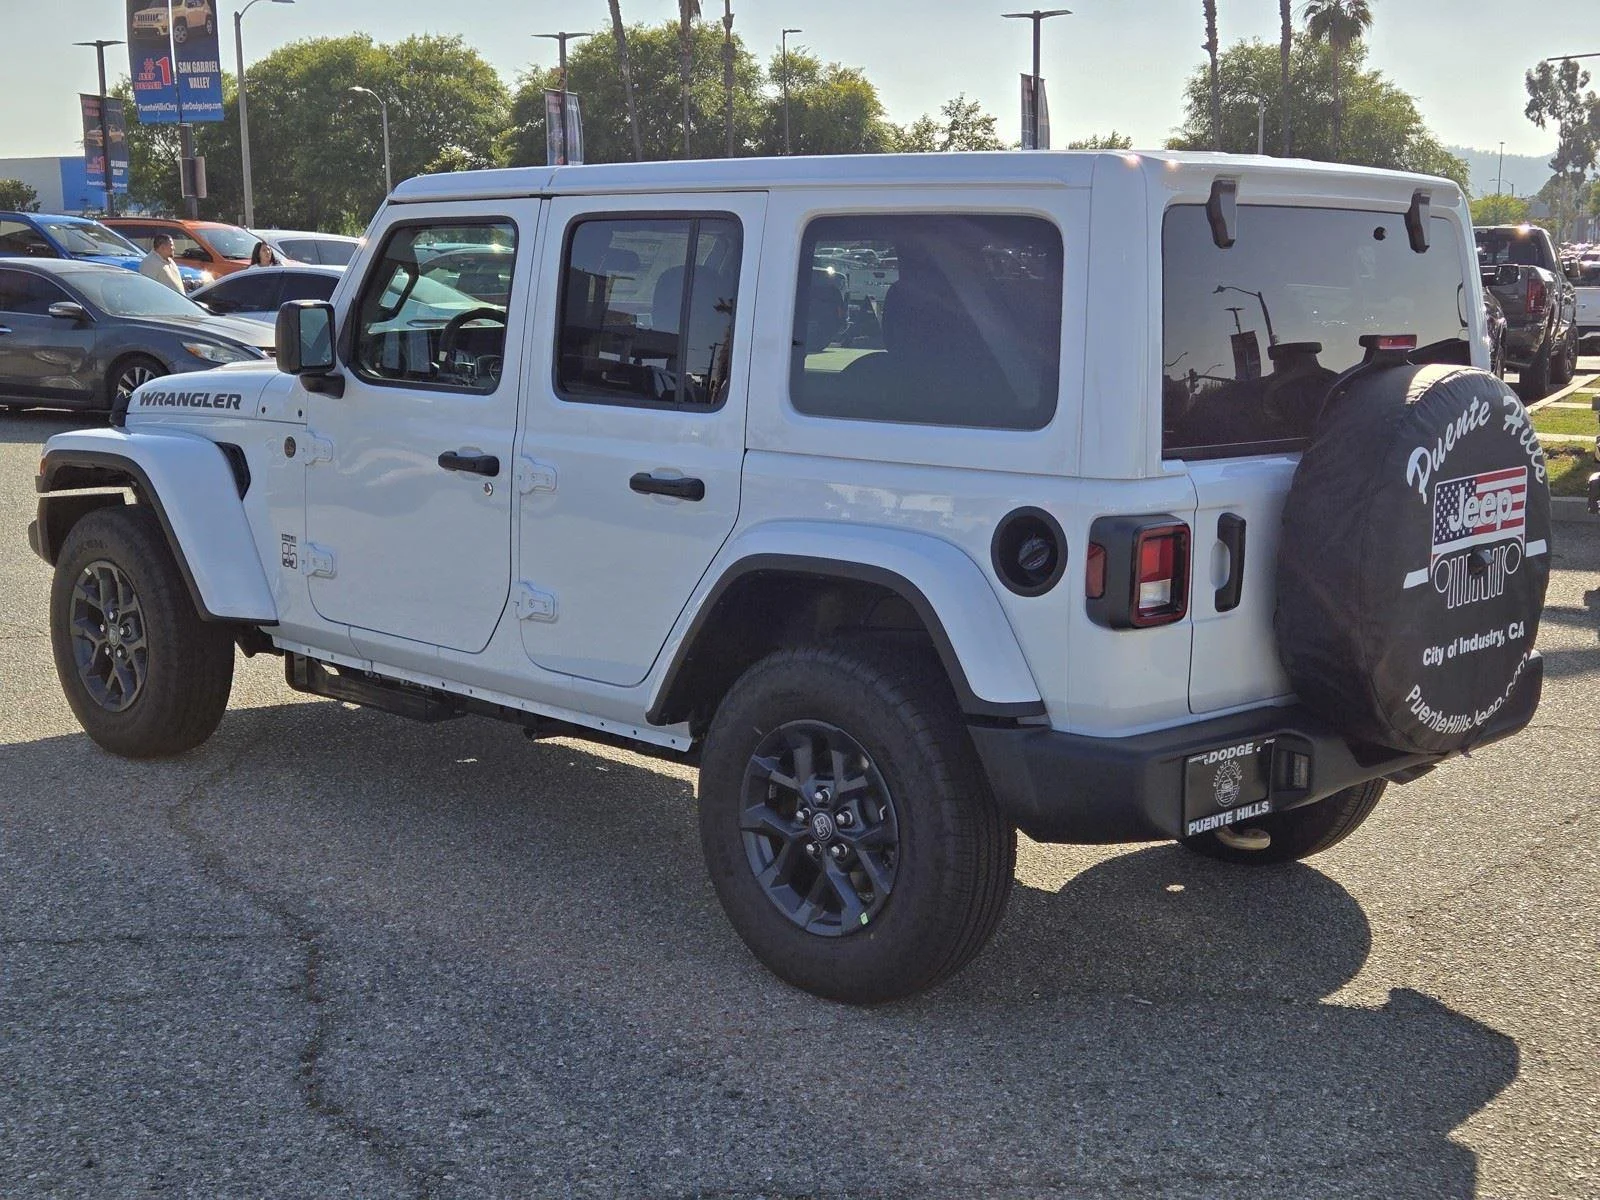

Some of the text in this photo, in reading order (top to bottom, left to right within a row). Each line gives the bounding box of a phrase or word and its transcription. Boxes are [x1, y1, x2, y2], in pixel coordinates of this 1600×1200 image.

[178, 60, 219, 74] SAN GABRIEL
[188, 76, 210, 89] VALLEY
[140, 391, 242, 410] WRANGLER
[1406, 395, 1546, 505] Puente Hills
[1447, 486, 1513, 532] Jeep
[1422, 621, 1525, 666] City of Industry, CA
[1405, 652, 1528, 735] PuenteHillsJeep.com
[1208, 742, 1254, 764] DODGE
[1188, 800, 1270, 836] PUENTE HILLS
